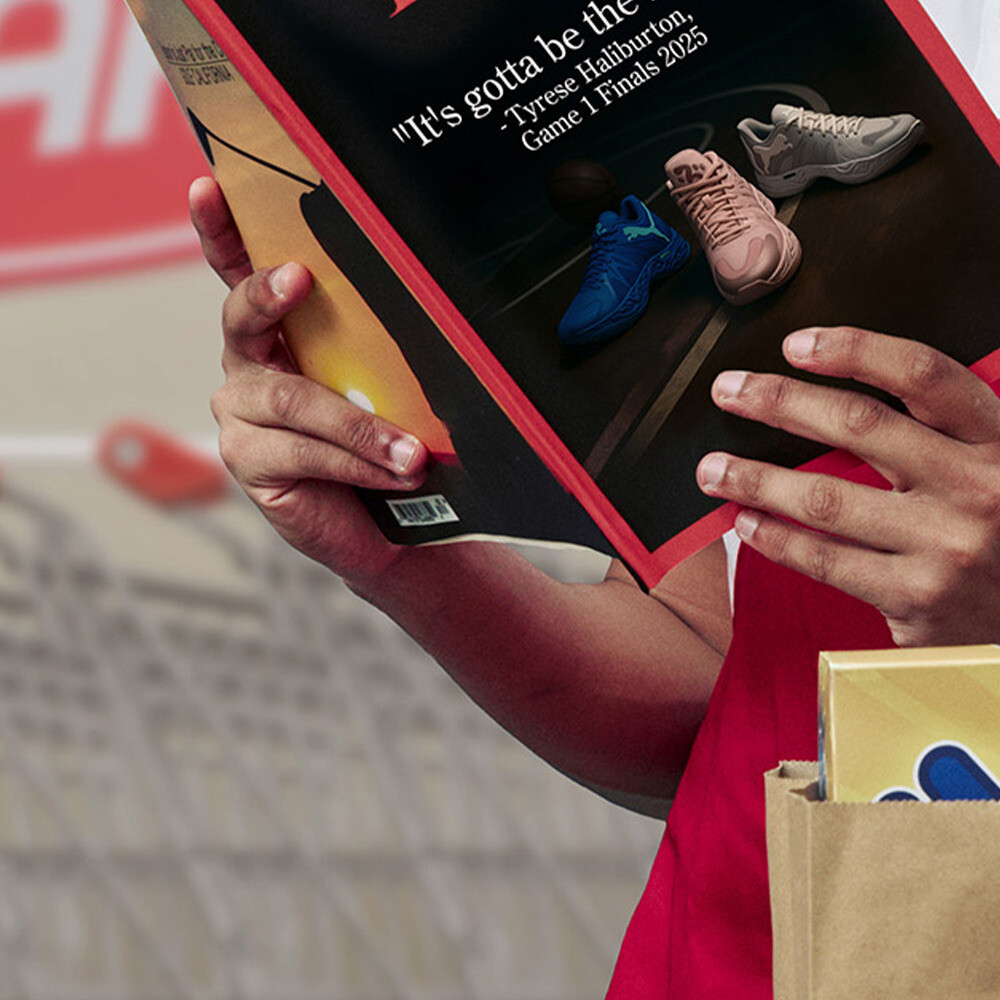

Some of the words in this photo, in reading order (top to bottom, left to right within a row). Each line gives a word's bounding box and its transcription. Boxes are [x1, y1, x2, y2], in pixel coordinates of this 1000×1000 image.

[391, 105, 463, 147] "It's
[463, 55, 544, 120] gotta
[533, 28, 585, 63] be
[582, 0, 640, 36] the
[503, 77, 580, 126] Tyrese
[574, 10, 694, 84] Haliburton,
[521, 109, 583, 151] Game
[580, 95, 599, 116] 1
[593, 60, 661, 106] Finals
[656, 25, 708, 68] 2025
